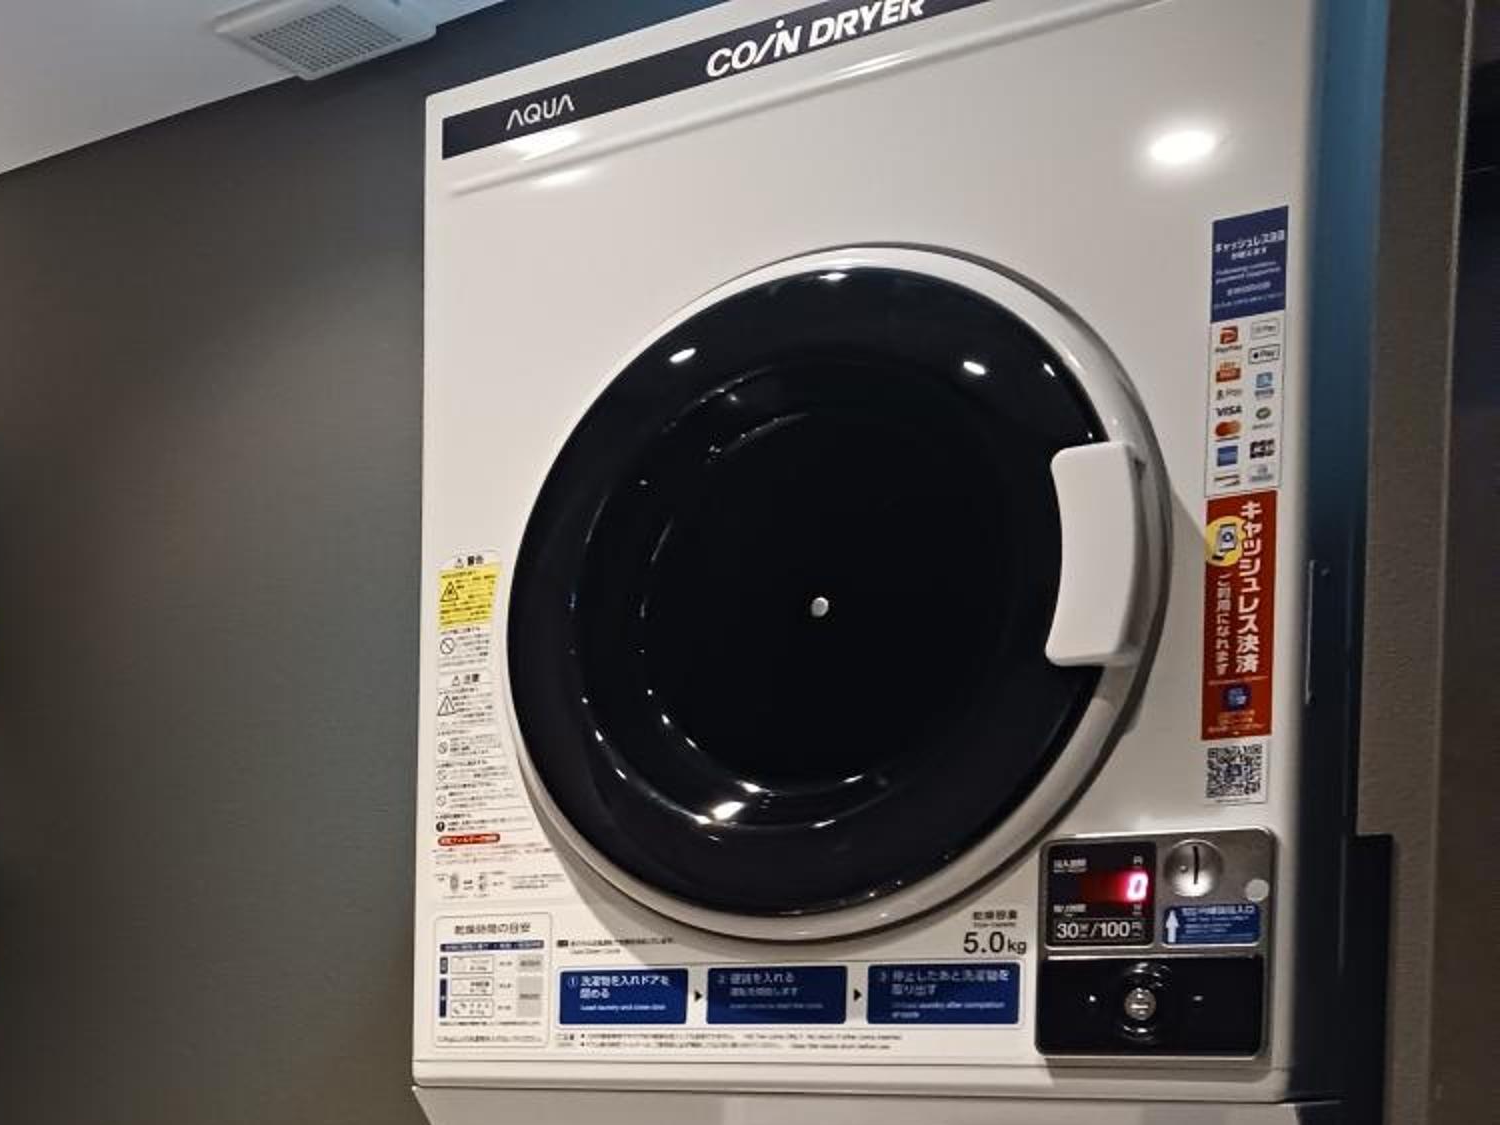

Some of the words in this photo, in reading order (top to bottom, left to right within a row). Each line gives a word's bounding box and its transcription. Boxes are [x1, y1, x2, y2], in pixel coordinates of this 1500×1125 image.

[705, 19, 800, 79] COIN
[808, 0, 925, 59] DRYER
[506, 93, 575, 131] AQUA
[1236, 500, 1263, 674] キャッシュレス決済
[1127, 872, 1149, 902] 0
